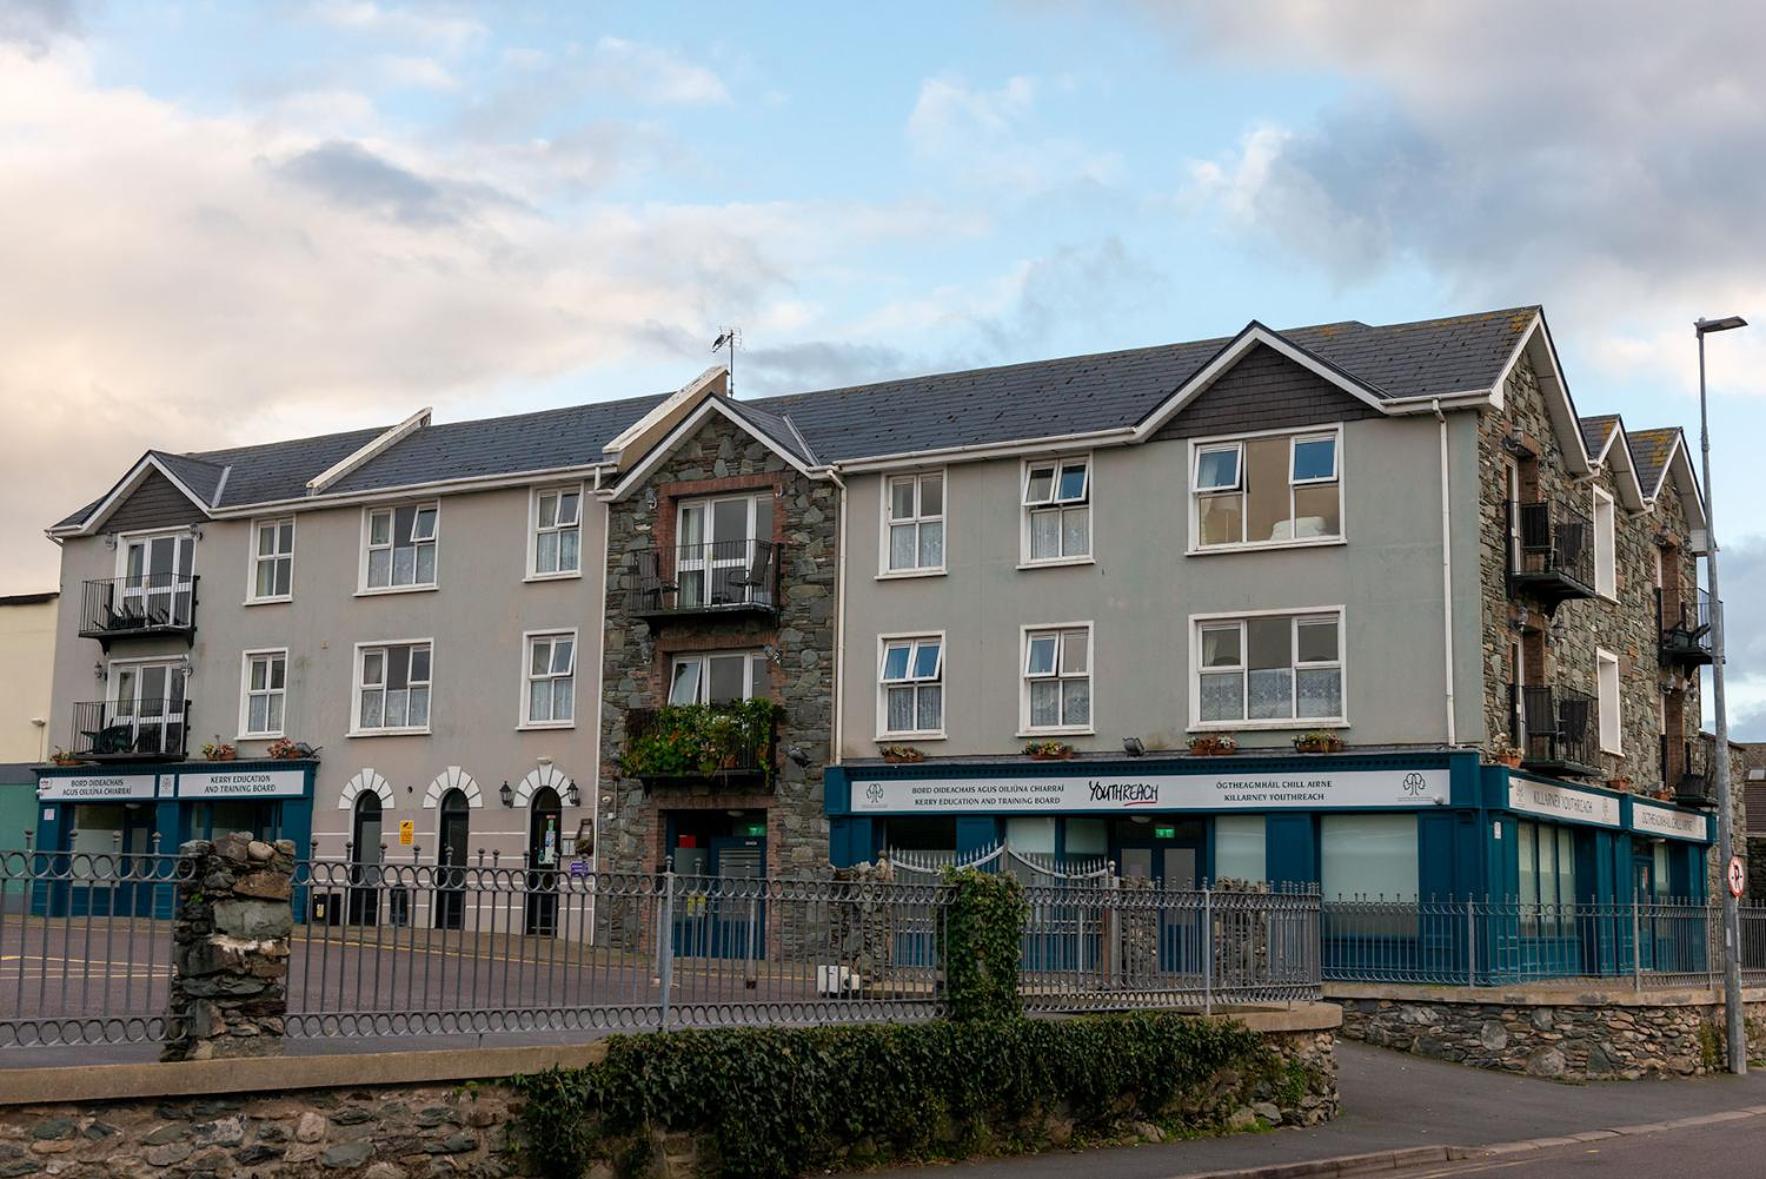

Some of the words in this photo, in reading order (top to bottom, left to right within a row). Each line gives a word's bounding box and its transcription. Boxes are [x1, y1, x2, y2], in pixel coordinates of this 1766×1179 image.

[210, 776, 231, 784] KERRY
[232, 774, 271, 783] EDUCATION
[204, 785, 219, 793] AND
[220, 784, 251, 793] TRAINING
[252, 784, 276, 792] BOARD
[1281, 780, 1305, 788] CHILL
[1307, 780, 1333, 788] AIRNE
[911, 786, 932, 794] BORD
[933, 786, 976, 794] OIDEACHAIS
[977, 785, 997, 793] AGUS
[914, 798, 937, 806] KERRY
[938, 797, 979, 805] EDUCATION
[981, 797, 997, 805] AND
[998, 797, 1033, 805] TRAINING
[1034, 796, 1061, 804] BOARD
[1223, 793, 1267, 801] KILLARNEY
[1269, 793, 1325, 801] YOUTHREACH
